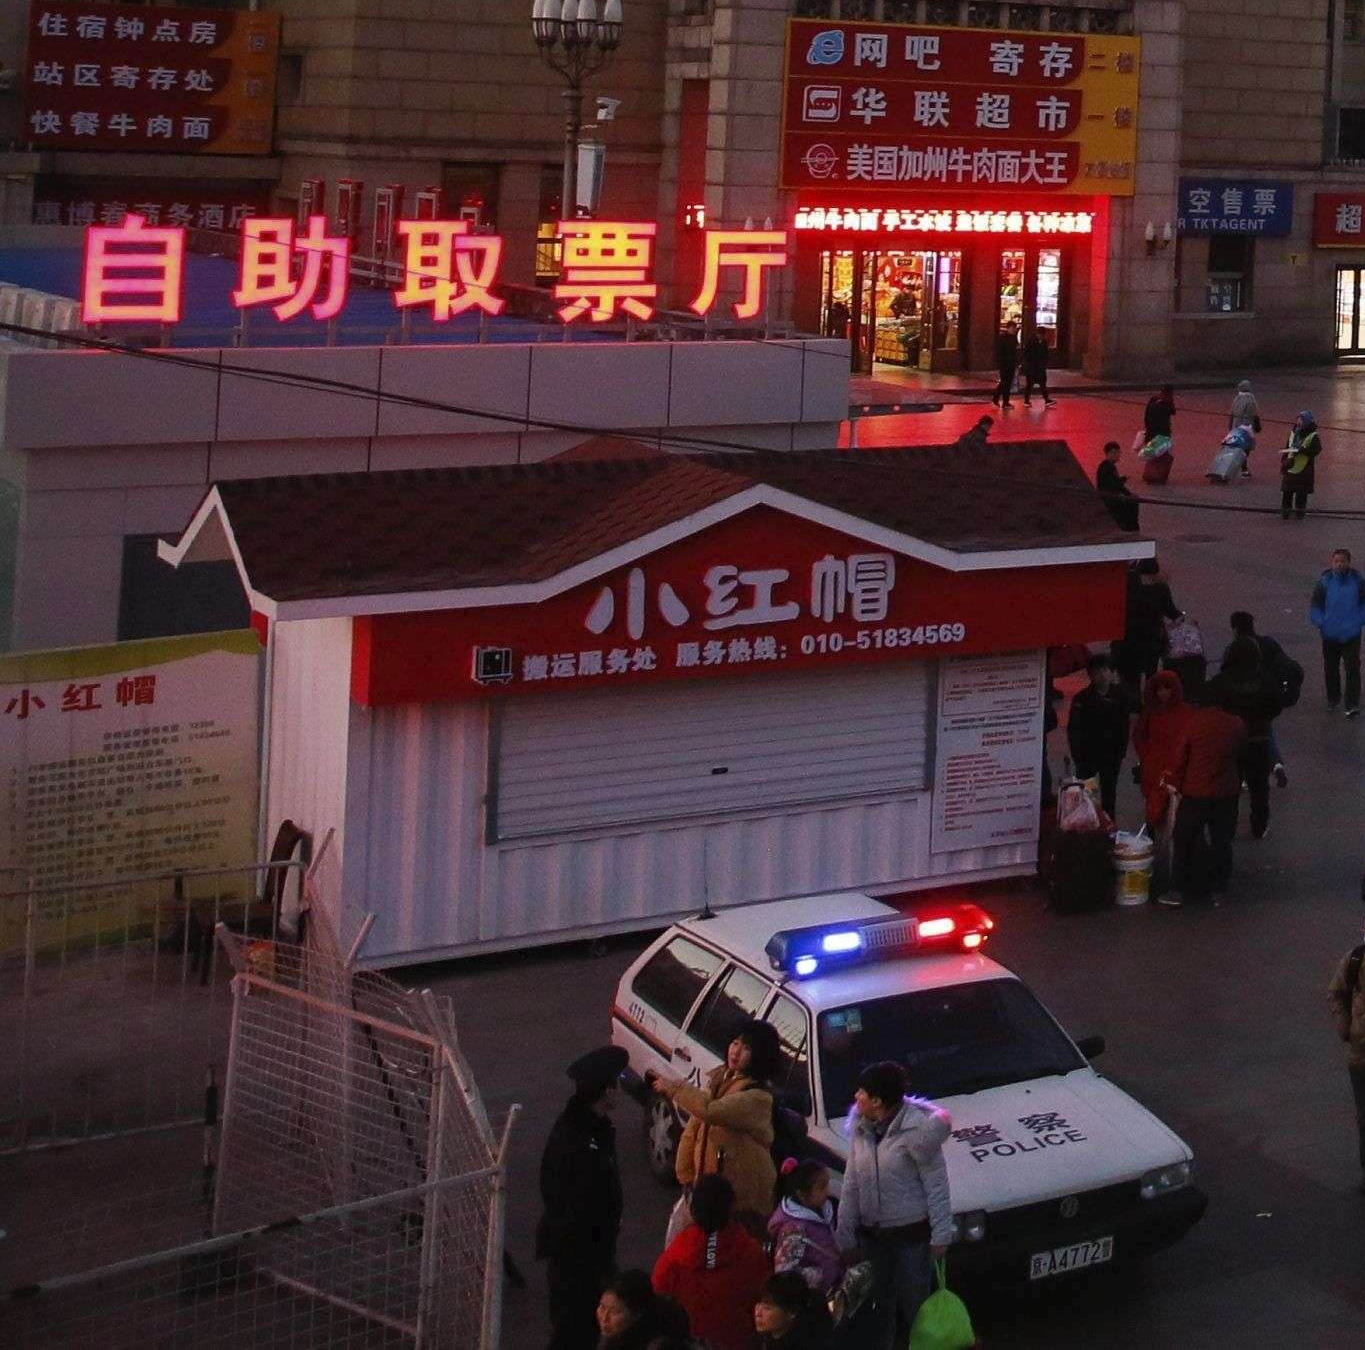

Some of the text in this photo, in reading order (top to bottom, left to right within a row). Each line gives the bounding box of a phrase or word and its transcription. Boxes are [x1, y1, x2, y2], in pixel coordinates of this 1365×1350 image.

[38, 12, 217, 45] 住宿钟点房
[33, 61, 215, 92] 站区寄存处
[854, 33, 1074, 78] 网吧 寄存
[30, 109, 213, 140] 快餐牛肉面
[850, 87, 1071, 132] 华联超市
[847, 144, 1069, 184] 美国加州牛肉面大王
[82, 214, 788, 326] 自助取票厅
[584, 552, 896, 640] 小红帽
[522, 647, 657, 682] 搬运服务处
[800, 623, 966, 655] 010-51834569
[4, 674, 156, 719] 小红帽
[951, 1111, 1070, 1148] 警察
[970, 1127, 1088, 1163] POLICE
